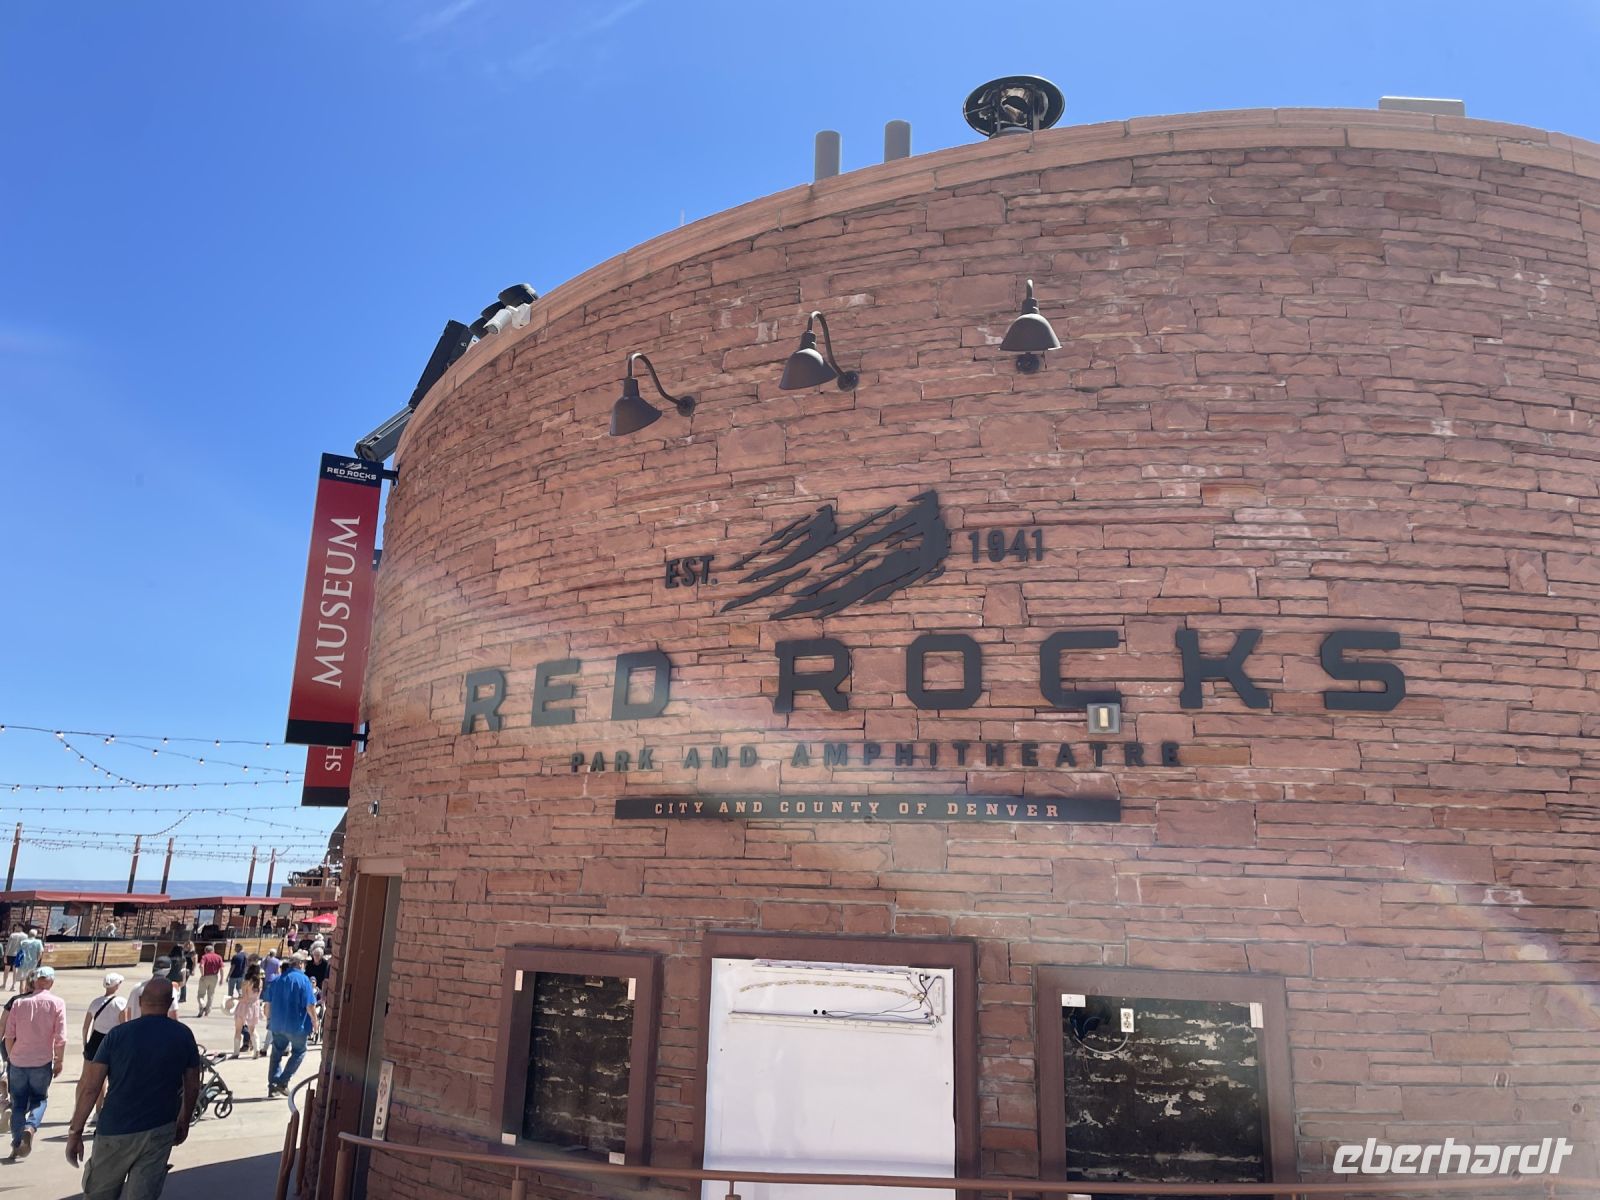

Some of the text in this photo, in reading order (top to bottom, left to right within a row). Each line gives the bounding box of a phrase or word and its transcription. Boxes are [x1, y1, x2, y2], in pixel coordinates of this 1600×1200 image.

[327, 466, 346, 475] RED
[347, 470, 377, 480] ROCKS
[968, 528, 1044, 564] 1941
[664, 555, 718, 589] EST.
[312, 515, 361, 689] MUSEUM
[461, 628, 1406, 735] RED ROCKS
[570, 741, 1181, 773] PARK AND AMPHITHEATRE
[654, 800, 1059, 817] CITY AND COUNTY OF DENVER
